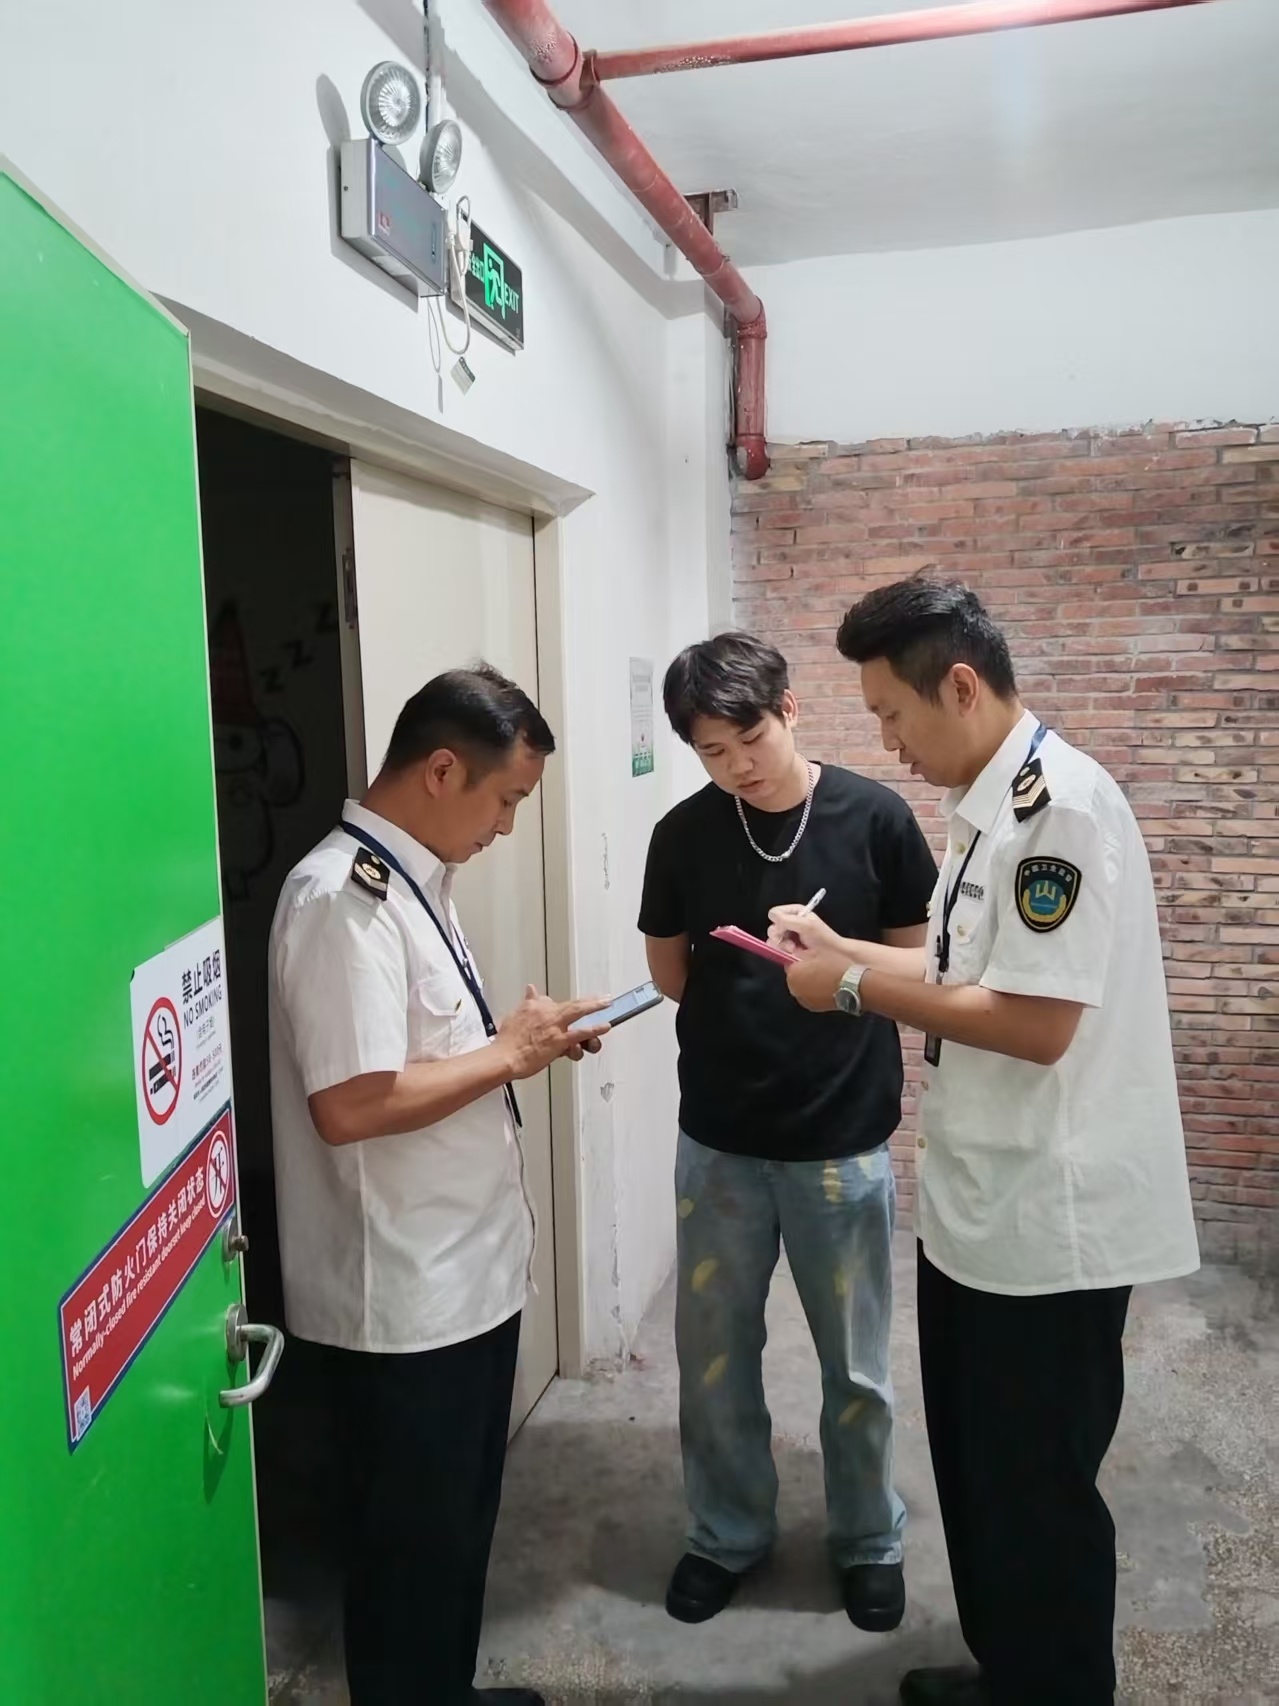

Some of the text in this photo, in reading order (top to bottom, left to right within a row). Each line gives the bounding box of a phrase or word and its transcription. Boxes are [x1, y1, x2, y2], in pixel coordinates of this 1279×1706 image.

[504, 281, 519, 314] EXIT
[182, 949, 221, 1005] 禁止吸烟
[183, 1007, 194, 1030] NO
[195, 984, 222, 1020] SMOKING
[69, 1166, 204, 1358] 常闭式防火门保持关闭状态
[72, 1299, 126, 1381] Normally-closed
[126, 1286, 137, 1310] fire
[137, 1253, 161, 1294] resistant
